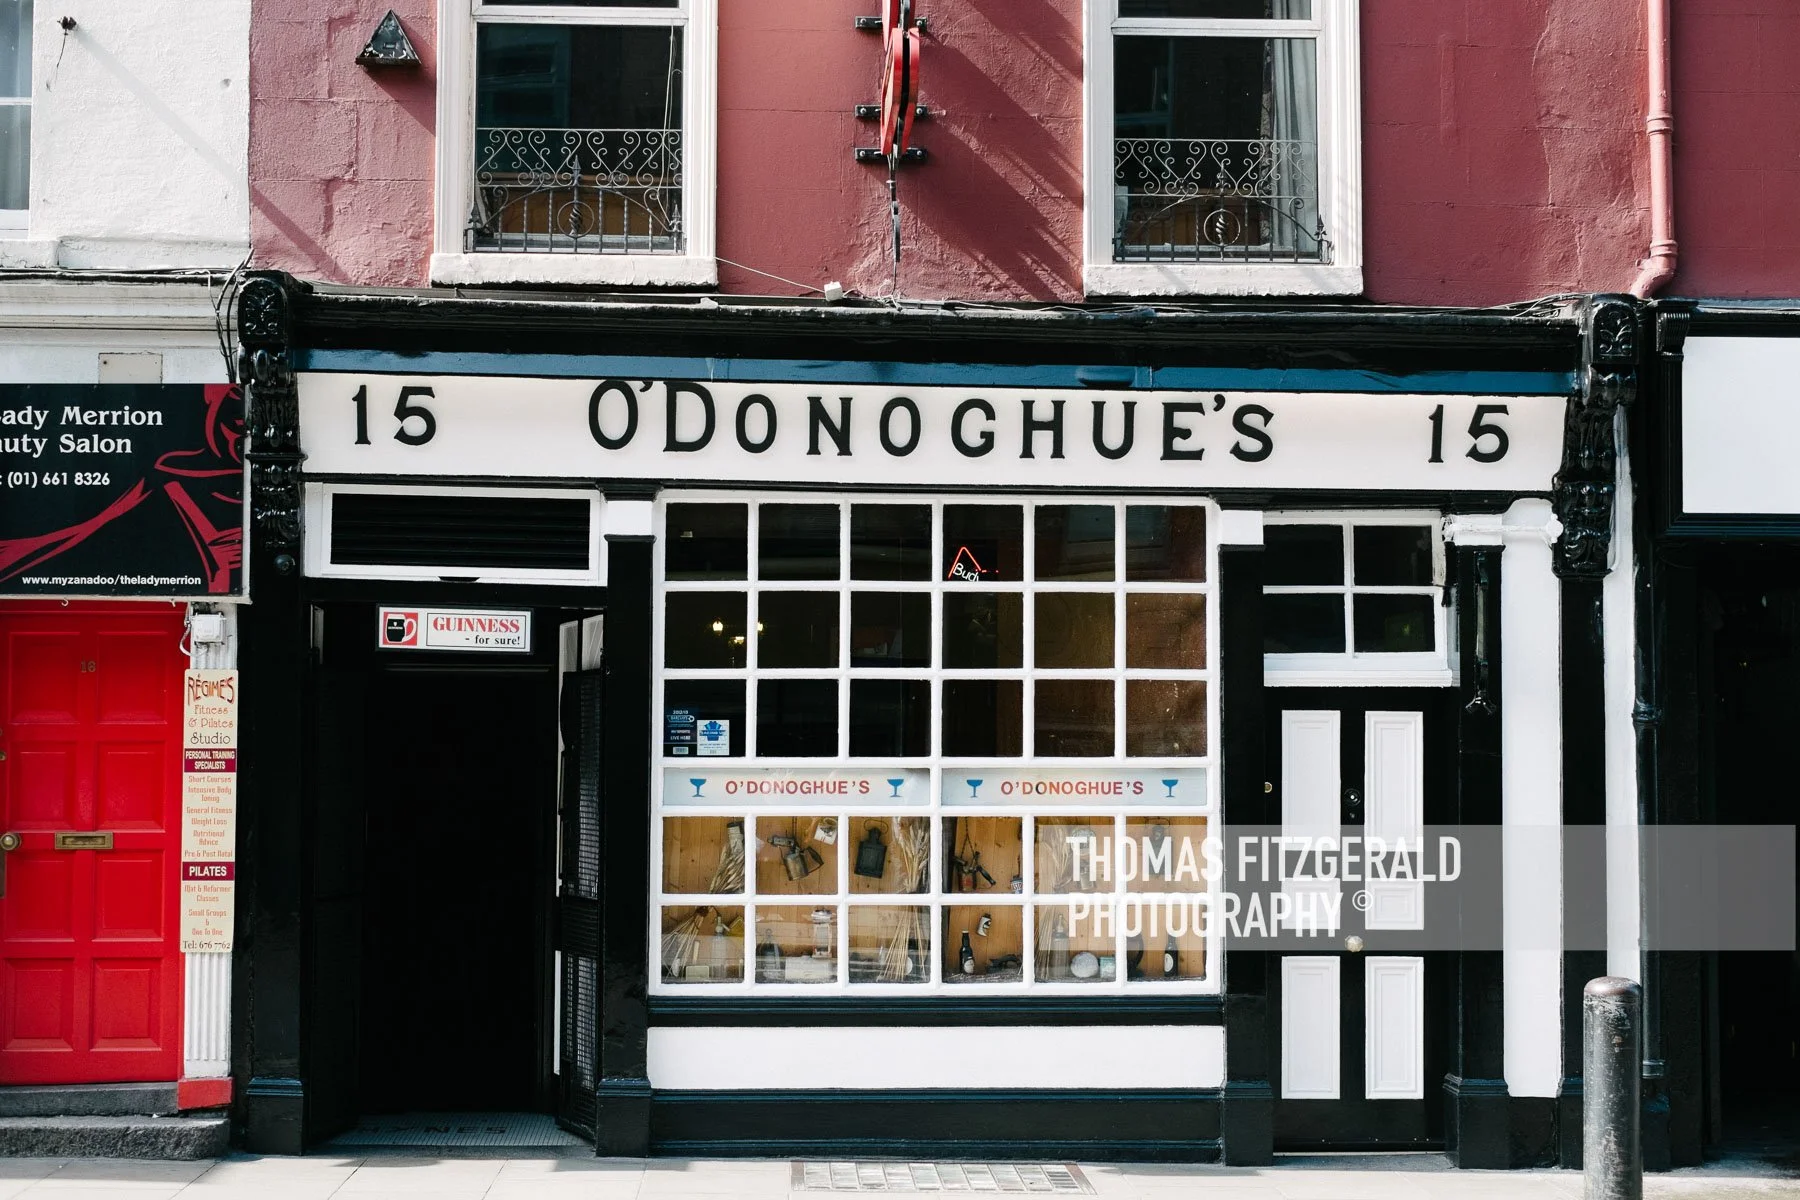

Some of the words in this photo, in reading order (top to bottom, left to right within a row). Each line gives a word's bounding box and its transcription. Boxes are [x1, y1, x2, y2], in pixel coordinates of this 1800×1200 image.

[0, 405, 49, 431] ady
[60, 405, 163, 426] Merrion
[351, 384, 437, 445] 15
[588, 380, 1275, 463] O'DONOGHUE'S
[1428, 404, 1510, 463] 15
[59, 433, 132, 454] Salon
[7, 472, 38, 489] (01)
[42, 472, 68, 485] 661
[74, 472, 111, 486] 8326
[22, 575, 201, 587] www.myzanadoo/theladymerrion
[432, 616, 520, 633] GUINNESS
[475, 635, 490, 645] for
[495, 636, 520, 646] sure!
[194, 704, 228, 715] Fitness
[201, 716, 233, 728] Pilates
[190, 731, 231, 745] Studio
[185, 751, 212, 759] PERSONAL
[213, 751, 235, 759] TRAINING
[194, 761, 226, 770] SPECIALISTS
[725, 780, 870, 795] O'DONOGHUE'S
[1001, 780, 1144, 795] O'DONOGHUE'S
[189, 866, 227, 876] PILATES
[183, 941, 197, 949] Tel:
[199, 941, 213, 949] 676
